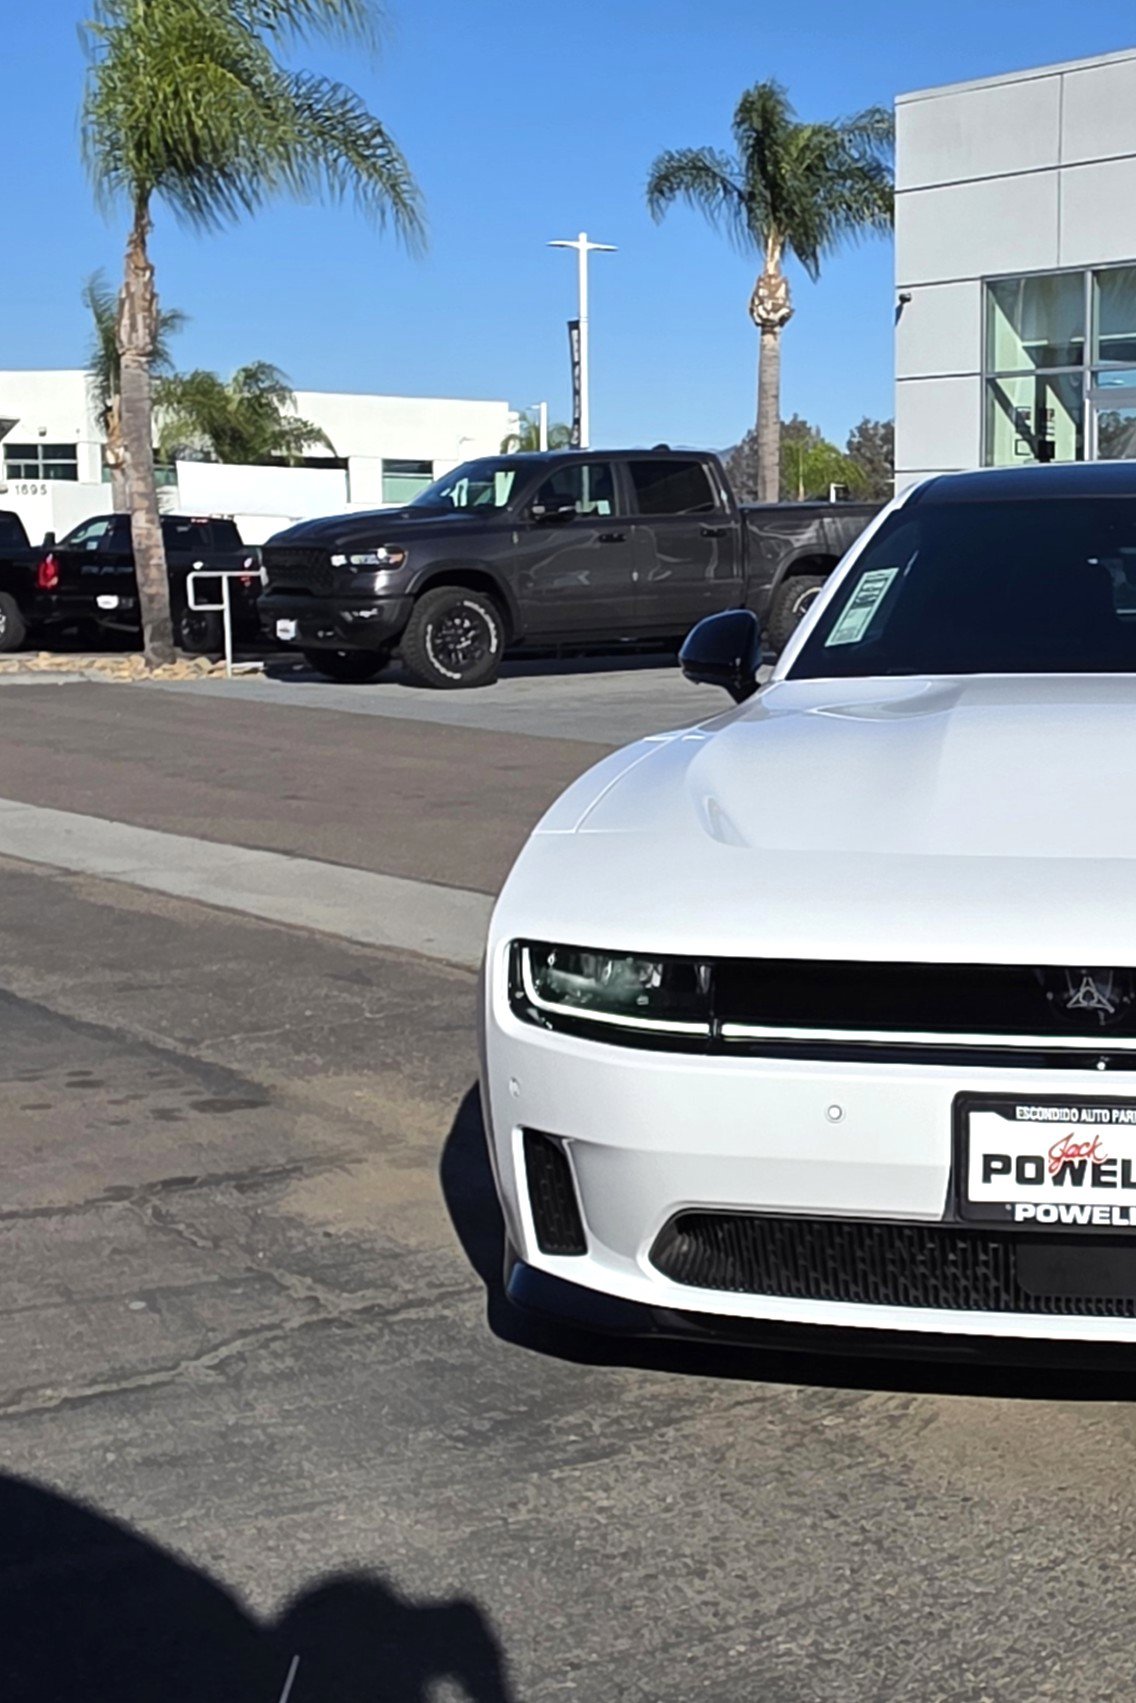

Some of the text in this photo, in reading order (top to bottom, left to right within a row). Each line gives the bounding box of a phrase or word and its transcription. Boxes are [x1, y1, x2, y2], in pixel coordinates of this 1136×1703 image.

[15, 484, 47, 496] 1695
[1016, 1106, 1079, 1121] ESCONDIDO
[1081, 1108, 1109, 1122] AUTO
[1048, 1132, 1107, 1173] Jack
